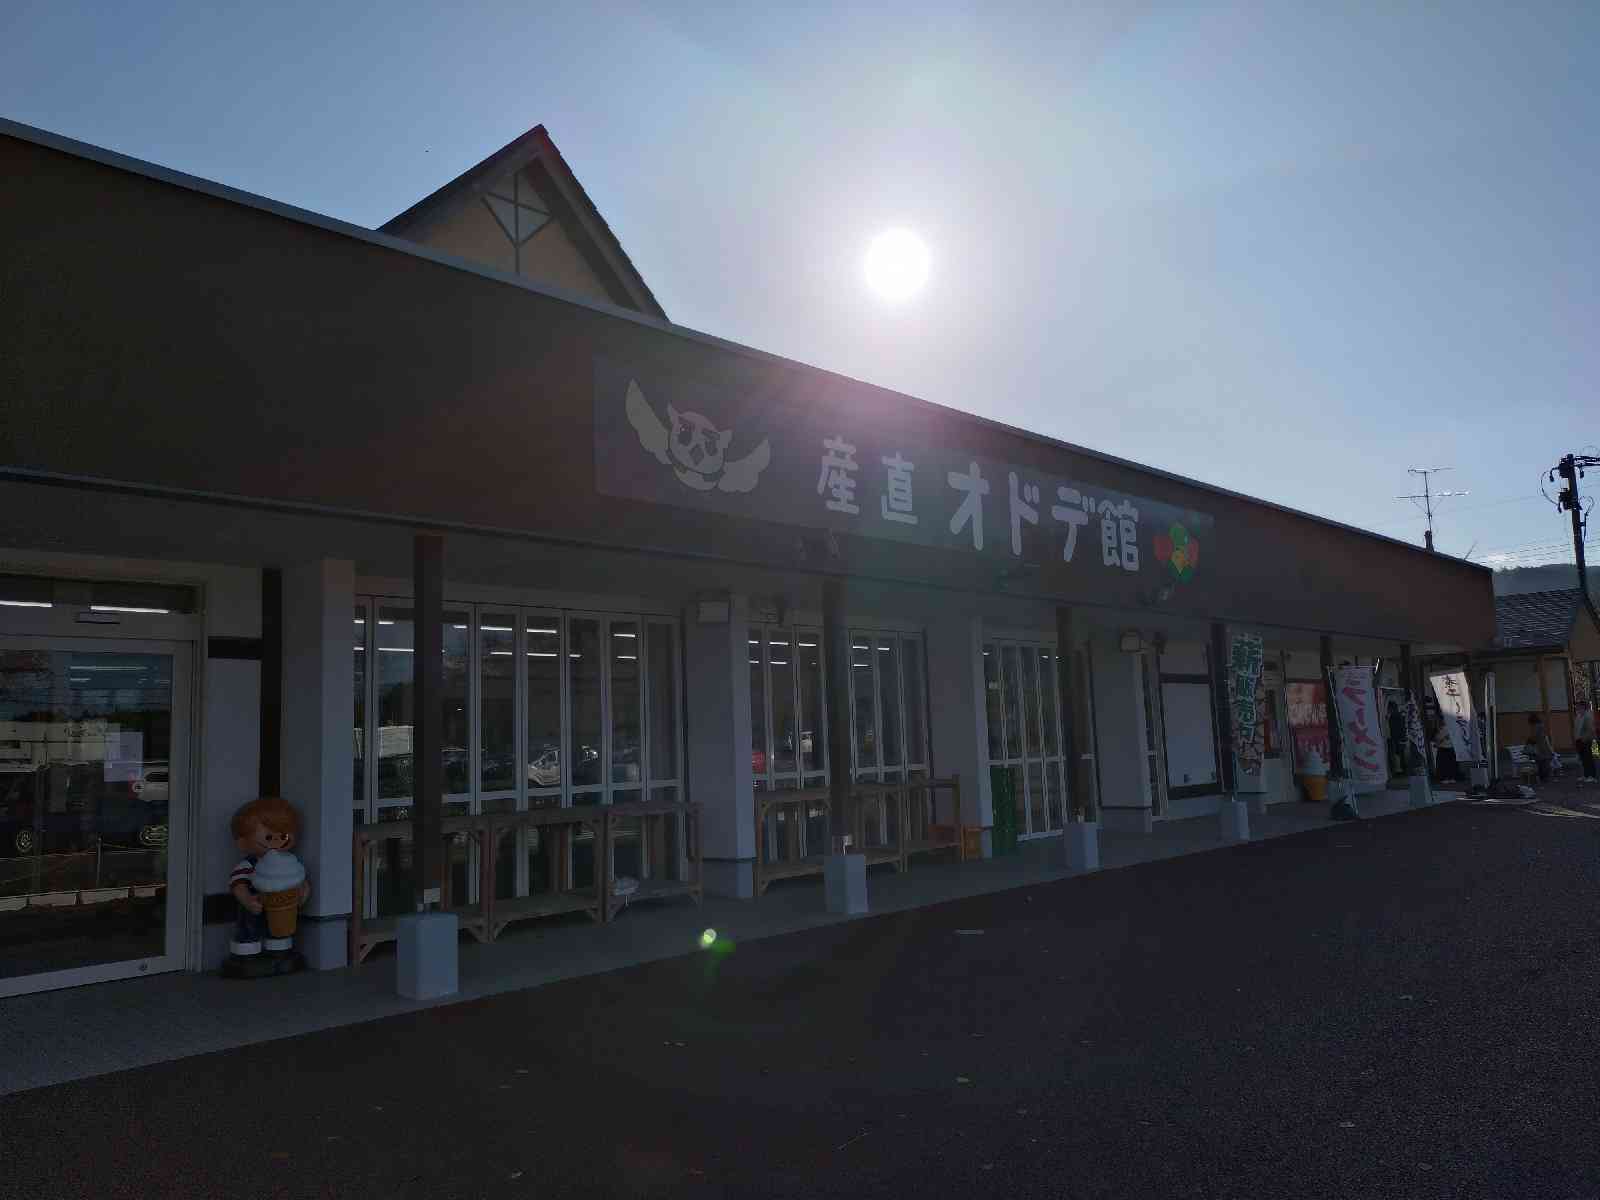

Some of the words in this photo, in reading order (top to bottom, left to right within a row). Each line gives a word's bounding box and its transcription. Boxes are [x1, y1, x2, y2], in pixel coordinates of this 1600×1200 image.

[817, 436, 1139, 571] 産直オドデ館
